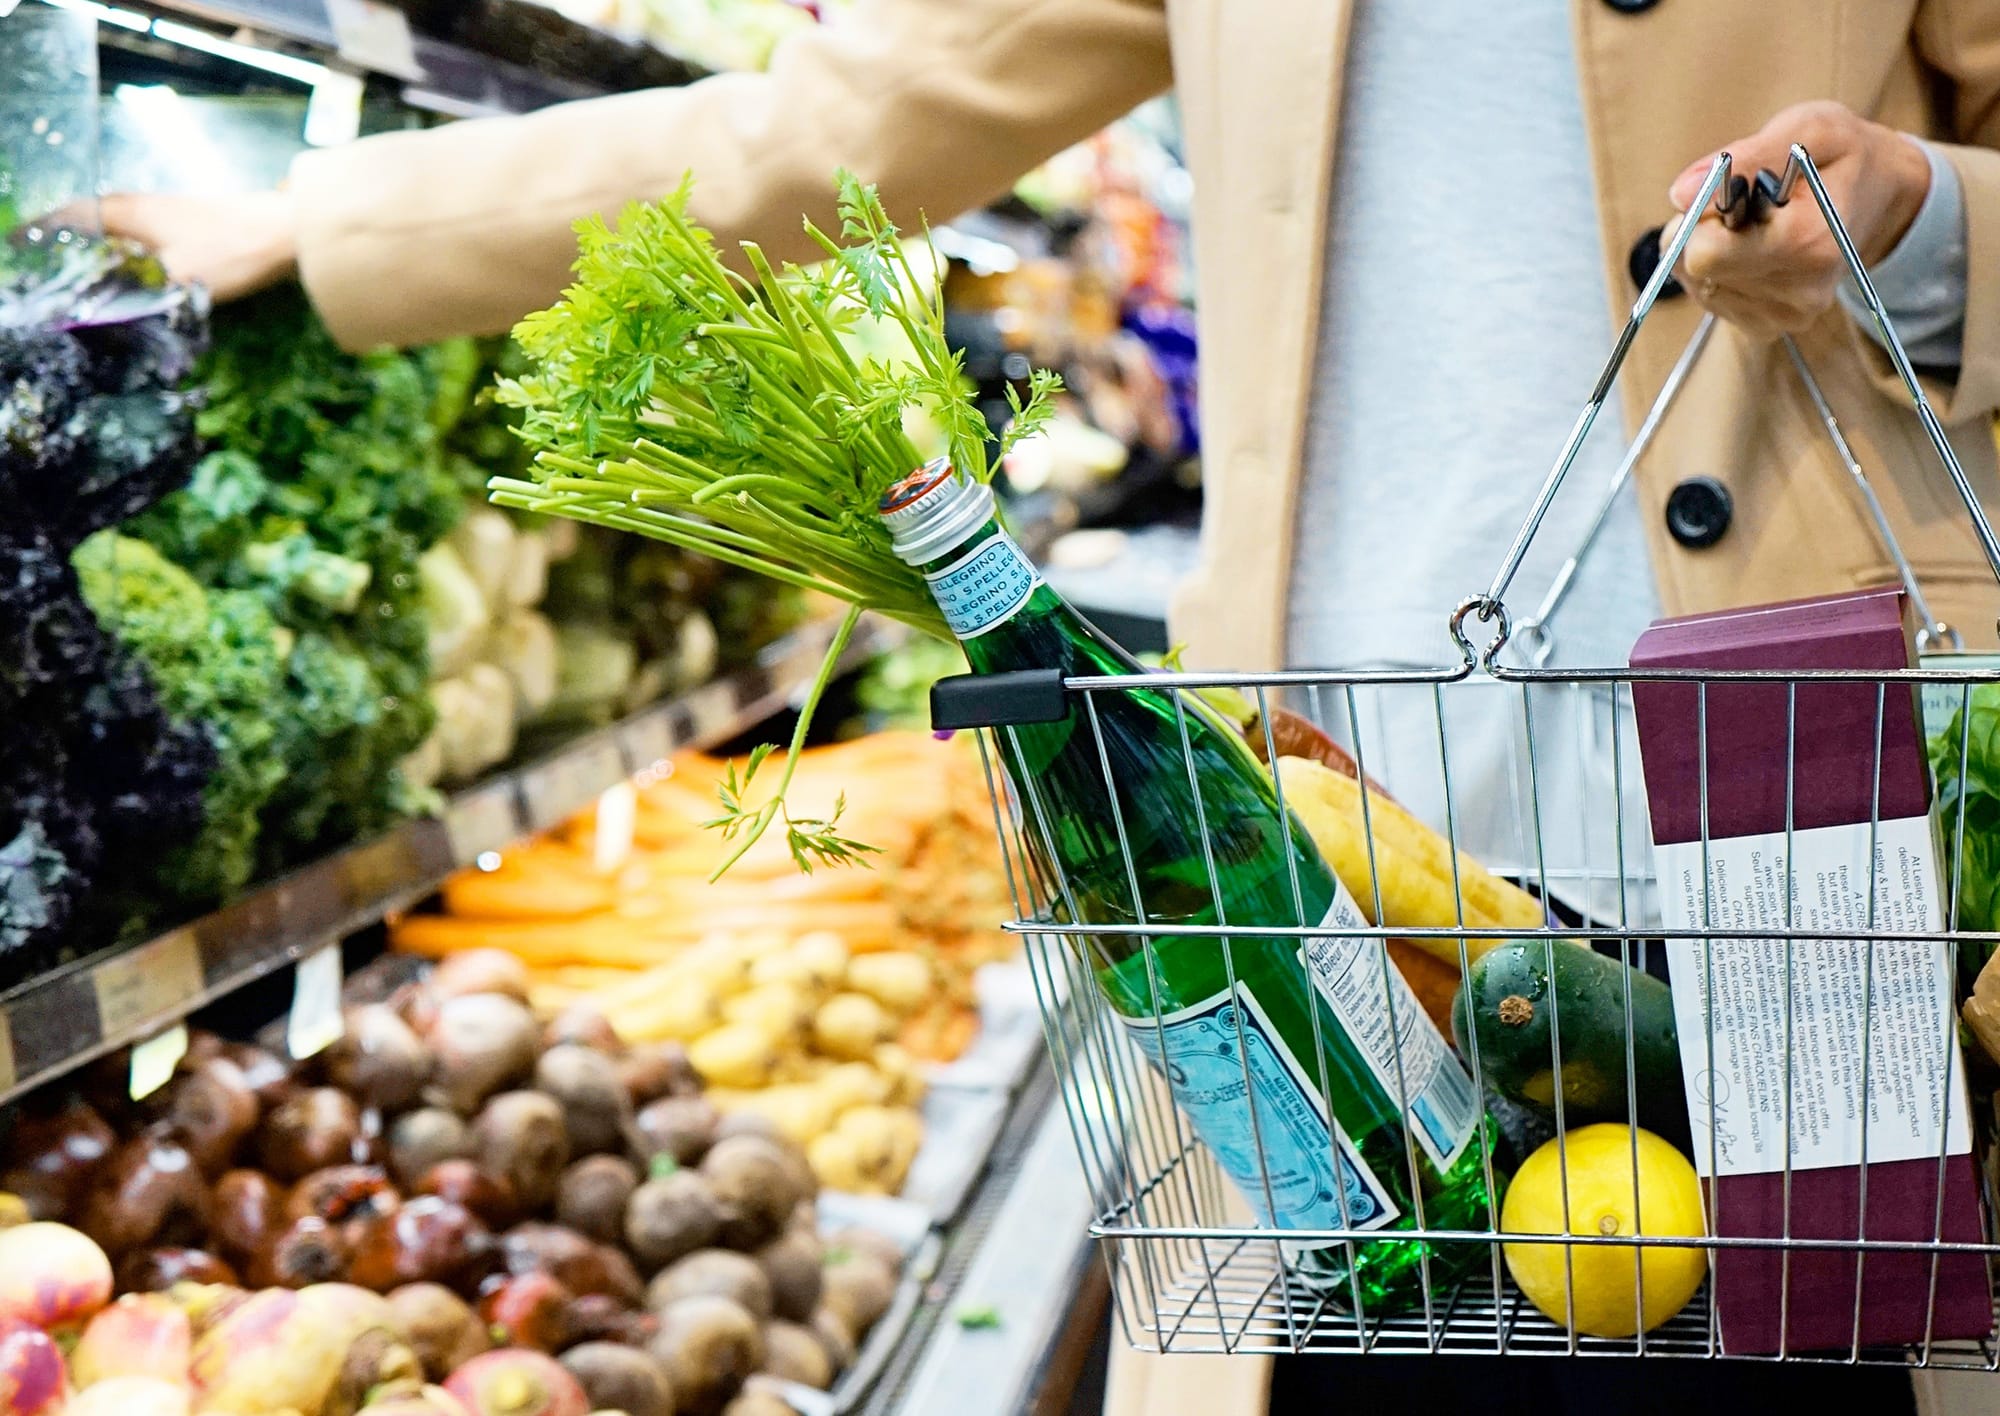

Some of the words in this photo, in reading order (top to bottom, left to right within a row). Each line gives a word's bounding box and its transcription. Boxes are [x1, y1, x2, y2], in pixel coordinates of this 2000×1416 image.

[961, 551, 1014, 597] S.PELLEG
[1750, 850, 1763, 874] Seul
[1773, 854, 1785, 869] de
[1871, 840, 1887, 875] Lesley
[1897, 845, 1912, 890] delicious
[1910, 853, 1921, 867] At
[1682, 868, 1692, 893] vous
[1715, 858, 1730, 904] Délicieux
[1753, 875, 1763, 889] un
[1763, 864, 1774, 890] avec
[1827, 870, 1838, 888] but
[1838, 864, 1851, 892] these
[1877, 875, 1888, 884] &
[1910, 867, 1926, 902] Lesley
[1685, 894, 1694, 908] ne
[1815, 871, 1829, 909] cheese
[1853, 890, 1863, 900] A
[1879, 885, 1891, 904] her
[1721, 905, 1731, 919] au
[1753, 889, 1770, 926] produit
[1820, 909, 1829, 921] or
[1827, 889, 1842, 917] really
[1840, 893, 1856, 929] unique
[1892, 899, 1901, 916] are
[1770, 916, 1779, 930] en
[1791, 903, 1804, 929] Stow
[1854, 901, 1868, 931] CRIS
[1881, 905, 1894, 932] team
[1894, 918, 1905, 947] mae
[1906, 918, 1920, 949] The
[1315, 943, 1344, 980] Valeur
[1690, 949, 1704, 971] plus
[1715, 947, 1725, 961] de
[1748, 938, 1765, 975] pouvait
[1815, 962, 1826, 971] &
[1836, 946, 1850, 974] when
[1847, 938, 1861, 972] ackers
[1875, 946, 1889, 984] scratch
[1898, 948, 1910, 970] with
[1728, 959, 1738, 978] ces
[1739, 954, 1753, 989] POUR
[1799, 960, 1813, 993] Foods
[1828, 971, 1840, 989] We
[1888, 959, 1900, 976] the
[1911, 950, 1926, 993] fabulous
[1924, 961, 1938, 993] Foods
[1763, 964, 1780, 1005] fabriqué
[1817, 973, 1826, 990] are
[1838, 974, 1854, 1010] topped
[1852, 973, 1862, 990] are
[1889, 977, 1903, 999] only
[1901, 970, 1912, 994] care
[1729, 978, 1747, 1030] craquelins
[1744, 988, 1756, 1013] CES
[1755, 976, 1771, 1021] satisfaire
[1790, 981, 1805, 1024] fabuleux
[1803, 993, 1817, 1023] adore
[1819, 991, 1830, 1014] sure
[1830, 990, 1840, 1007] are
[1878, 984, 1893, 1012] using
[1892, 1000, 1904, 1021] way
[1904, 995, 1915, 1006] in
[1914, 993, 1930, 1025] crisps
[1928, 994, 1938, 1010] we
[1724, 1013, 1734, 1027] de
[1747, 1013, 1760, 1041] FINS
[1771, 1006, 1781, 1030] avec
[1820, 1015, 1832, 1035] you
[1833, 1008, 1848, 1051] addicted
[1845, 1010, 1857, 1032] with
[1884, 1013, 1894, 1031] our
[1897, 1022, 1908, 1034] to
[1906, 1006, 1919, 1035] small
[1931, 1011, 1943, 1033] love
[1724, 1028, 1740, 1070] fromage
[1738, 1031, 1750, 1053] sont
[1759, 1021, 1775, 1054] Lesley
[1774, 1031, 1786, 1051] des
[1794, 1024, 1812, 1076] craquelins
[1805, 1024, 1823, 1069] fabriquer
[1825, 1036, 1837, 1052] will
[1846, 1032, 1858, 1055] your
[1886, 1031, 1899, 1059] finest
[1898, 1034, 1911, 1063] make
[1920, 1025, 1933, 1050] from
[1766, 1055, 1777, 1066] et
[1827, 1053, 1839, 1067] be
[1839, 1052, 1850, 1063] to
[1932, 1033, 1948, 1071] making
[1732, 1071, 1740, 1085] ou
[1750, 1041, 1770, 1114] CRAQUELINS
[1767, 1067, 1777, 1087] son
[1788, 1053, 1802, 1089] cuisine
[1813, 1069, 1824, 1080] et
[1840, 1064, 1852, 1083] this
[1902, 1063, 1911, 1071] a
[1922, 1050, 1939, 1091] Lesley's
[1741, 1054, 1758, 1110] irrésistibles
[1803, 1077, 1815, 1099] sont
[1815, 1081, 1826, 1106] vous
[1901, 1072, 1916, 1099] great
[1793, 1089, 1804, 1104] de
[1841, 1084, 1855, 1121] yummy
[1818, 1106, 1831, 1130] offrir
[1869, 1101, 1879, 1123] own
[1905, 1099, 1921, 1138] product
[1929, 1091, 1944, 1128] kitchen
[1804, 1100, 1821, 1147] fabriqués
